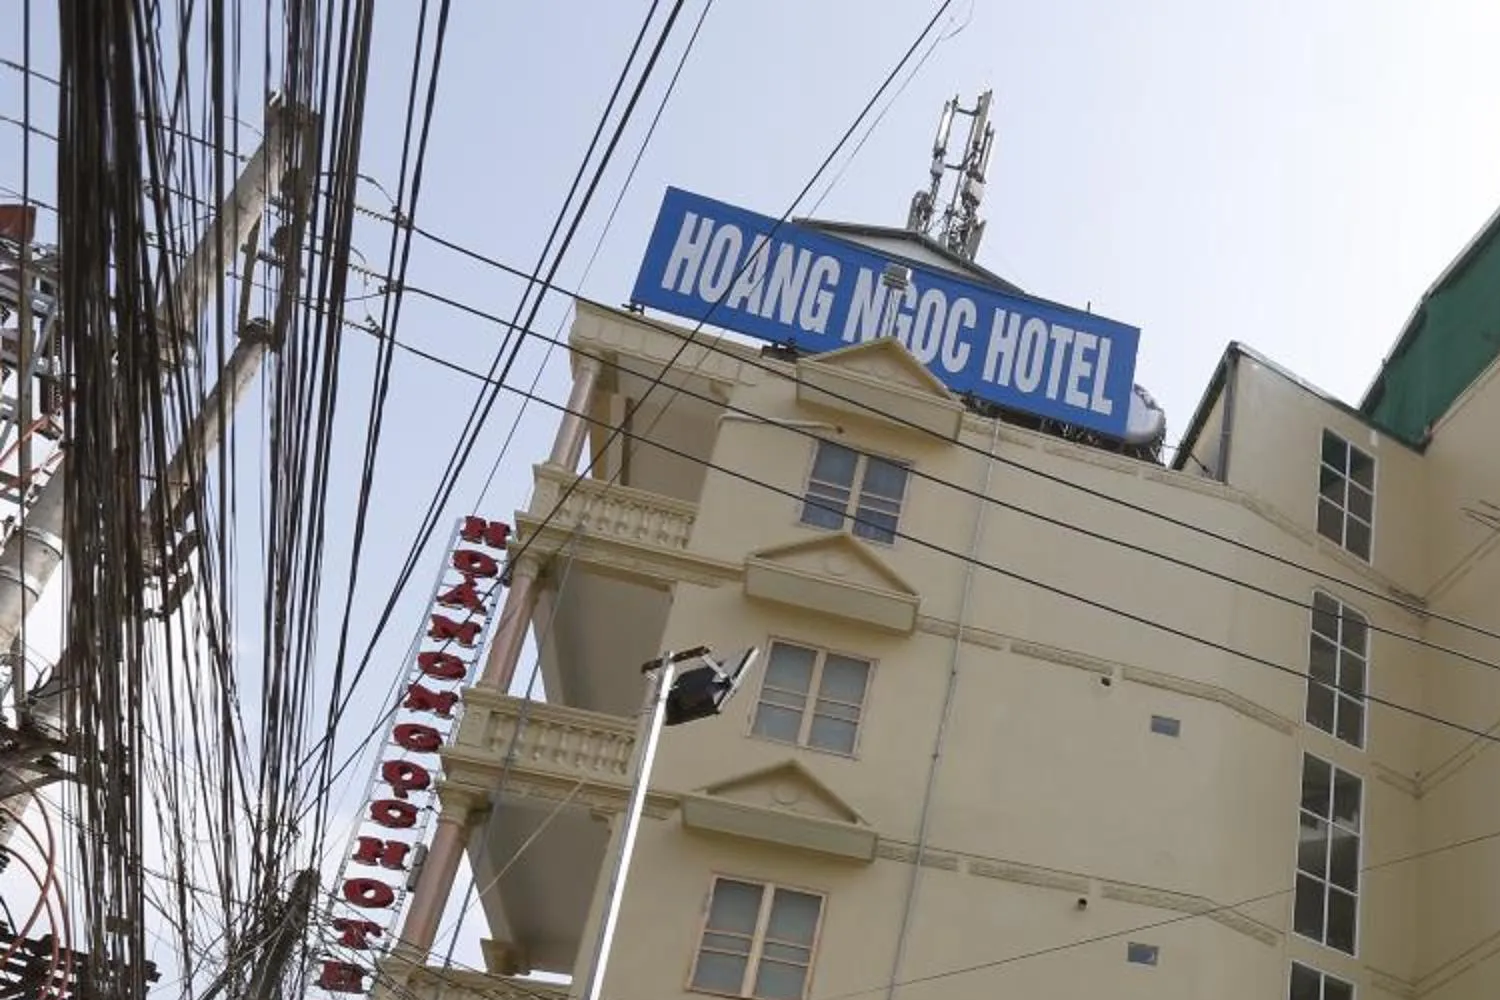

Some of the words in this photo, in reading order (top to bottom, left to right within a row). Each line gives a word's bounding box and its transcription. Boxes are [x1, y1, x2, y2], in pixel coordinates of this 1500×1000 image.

[662, 212, 841, 334] HOANG
[842, 267, 977, 373] NGOC
[982, 308, 1113, 416] HOTEL
